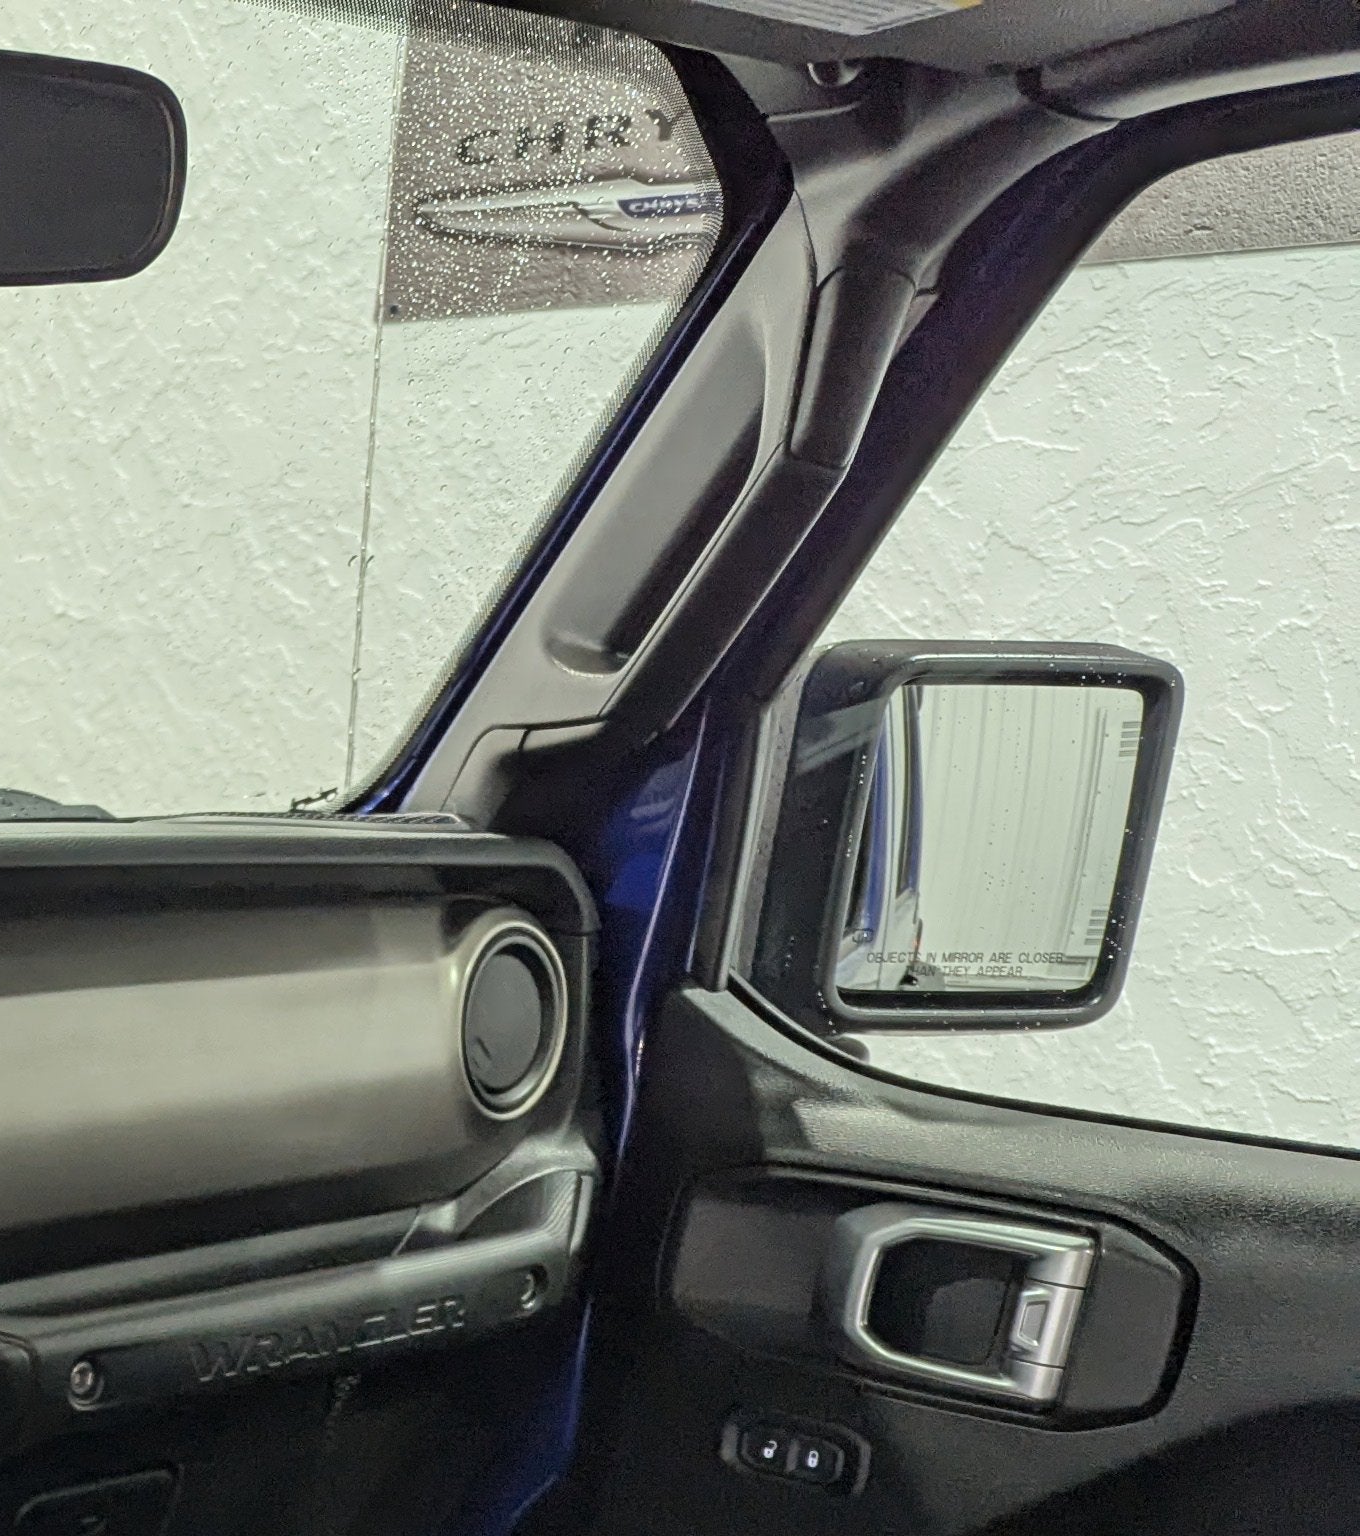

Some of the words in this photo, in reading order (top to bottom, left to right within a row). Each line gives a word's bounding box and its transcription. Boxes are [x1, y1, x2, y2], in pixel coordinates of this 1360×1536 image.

[866, 952, 922, 963] OBJECTS
[926, 952, 938, 963] IN
[941, 952, 984, 963] MIRROR
[989, 952, 1012, 963] ARE
[1018, 952, 1064, 964] CLOSER
[943, 965, 971, 976] THEY
[977, 965, 1023, 976] APPEAR
